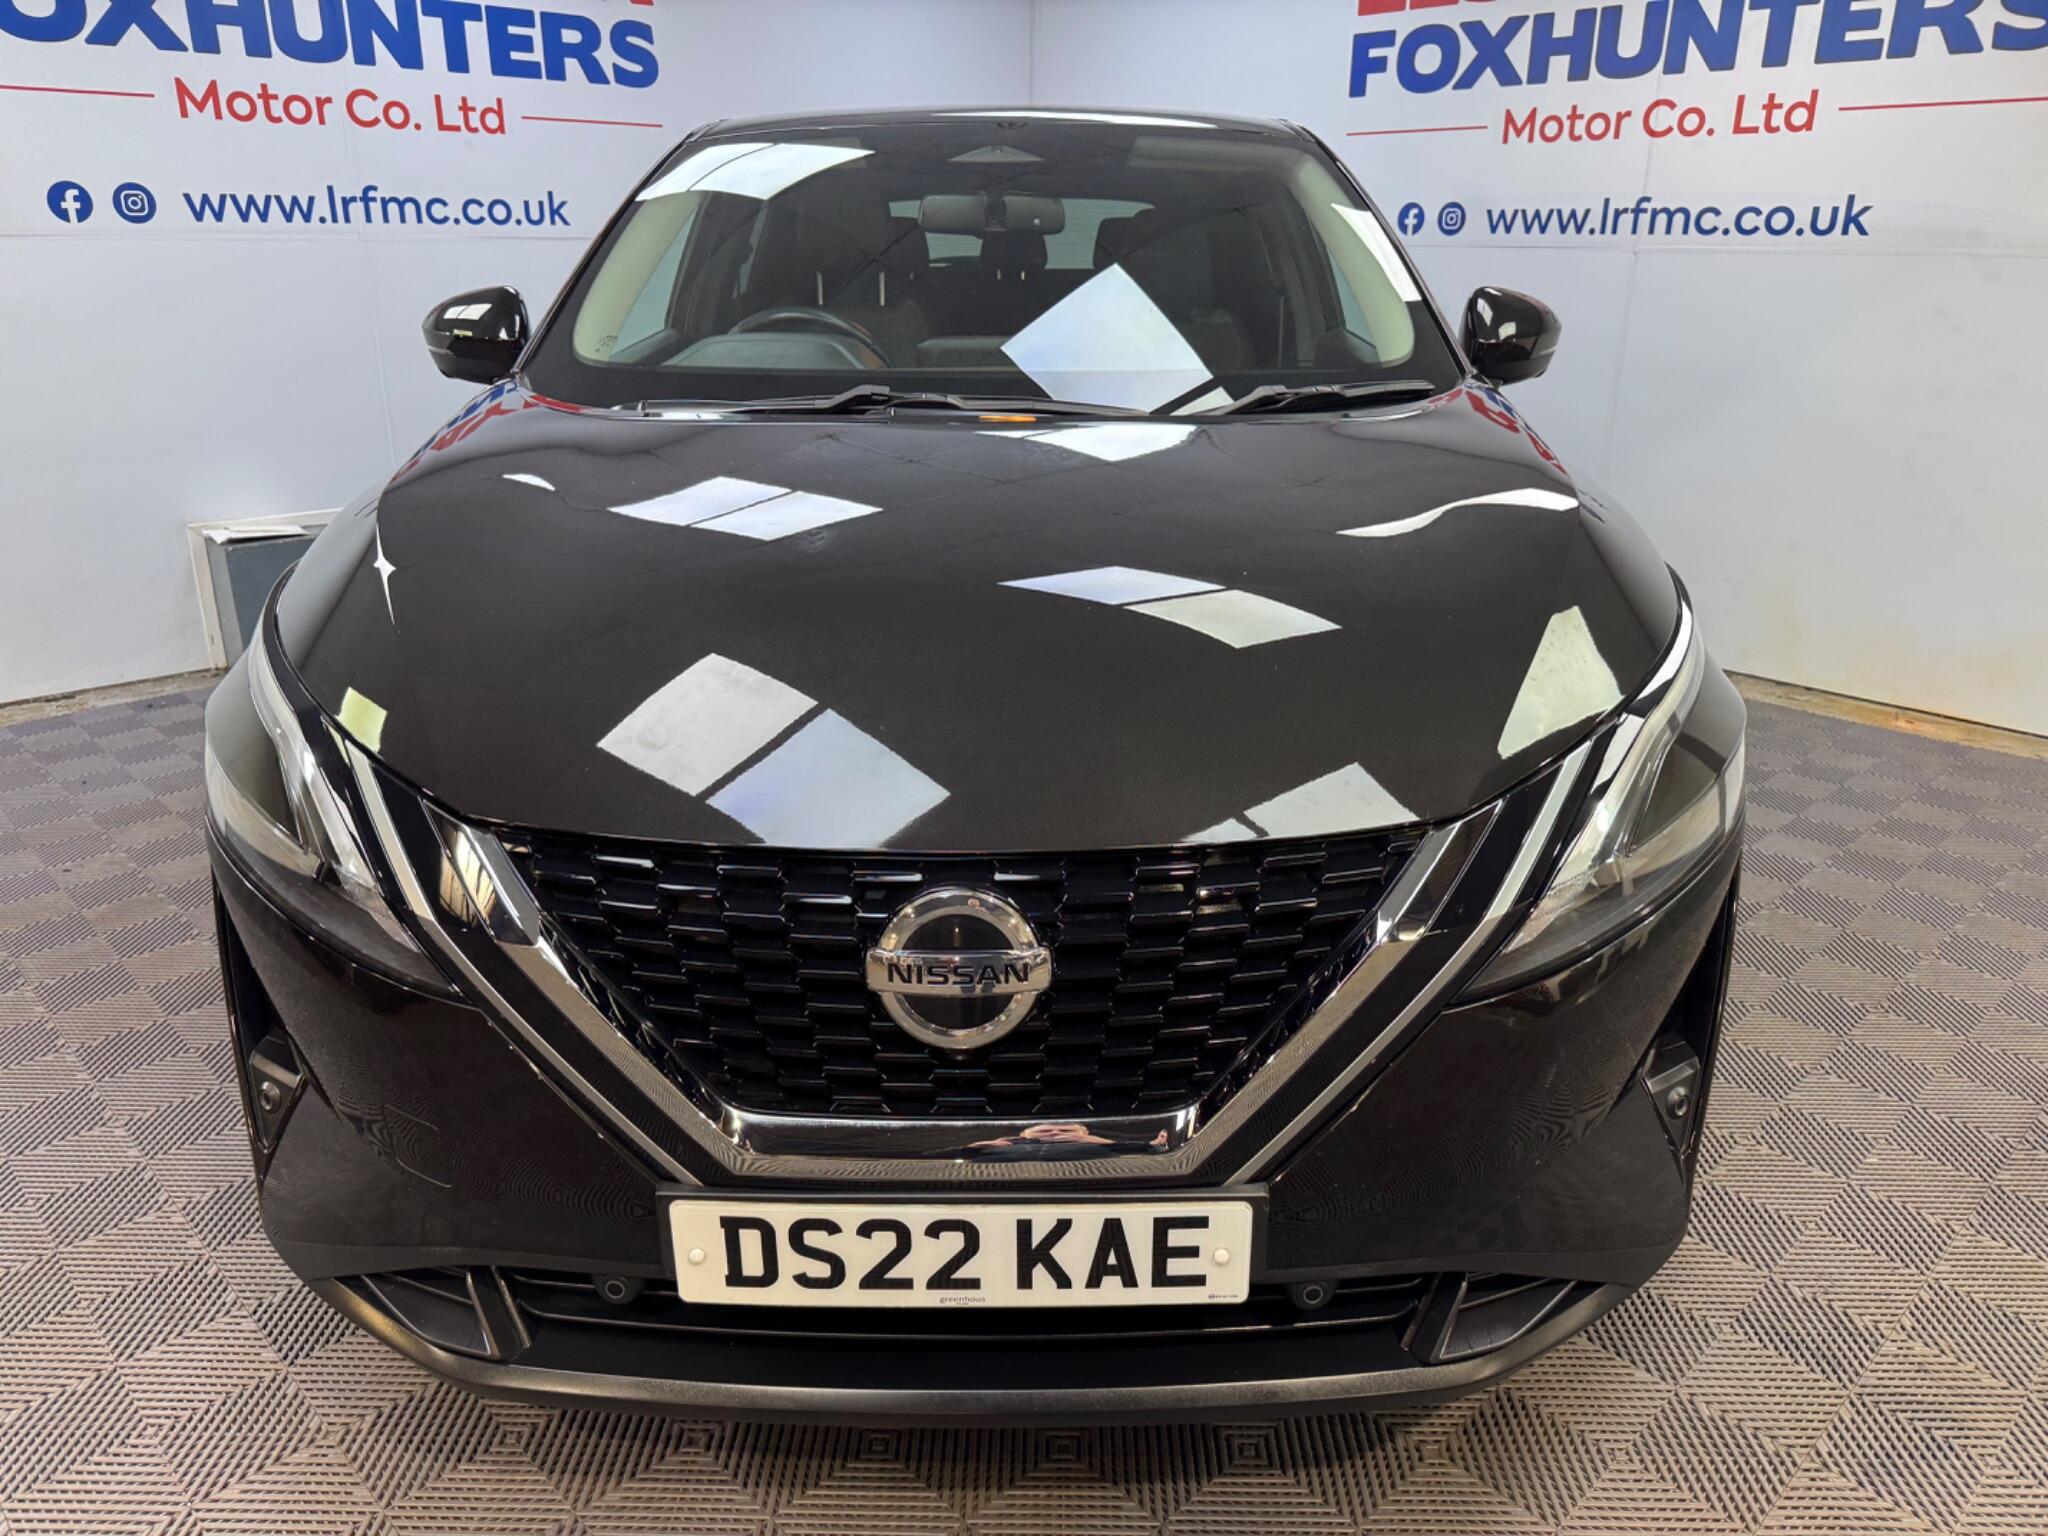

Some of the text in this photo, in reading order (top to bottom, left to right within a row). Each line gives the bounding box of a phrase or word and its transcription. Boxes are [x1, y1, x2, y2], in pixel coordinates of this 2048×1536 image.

[174, 77, 507, 135] Motor Co. Ltd
[1502, 89, 1820, 144] Motor Co. Ltd
[182, 184, 571, 227] www.lrfmc.co.uk
[1486, 194, 1874, 238] www.lrfmc.co.uk
[887, 963, 1031, 986] NISSAN
[719, 1215, 1210, 1290] DS22 KAE
